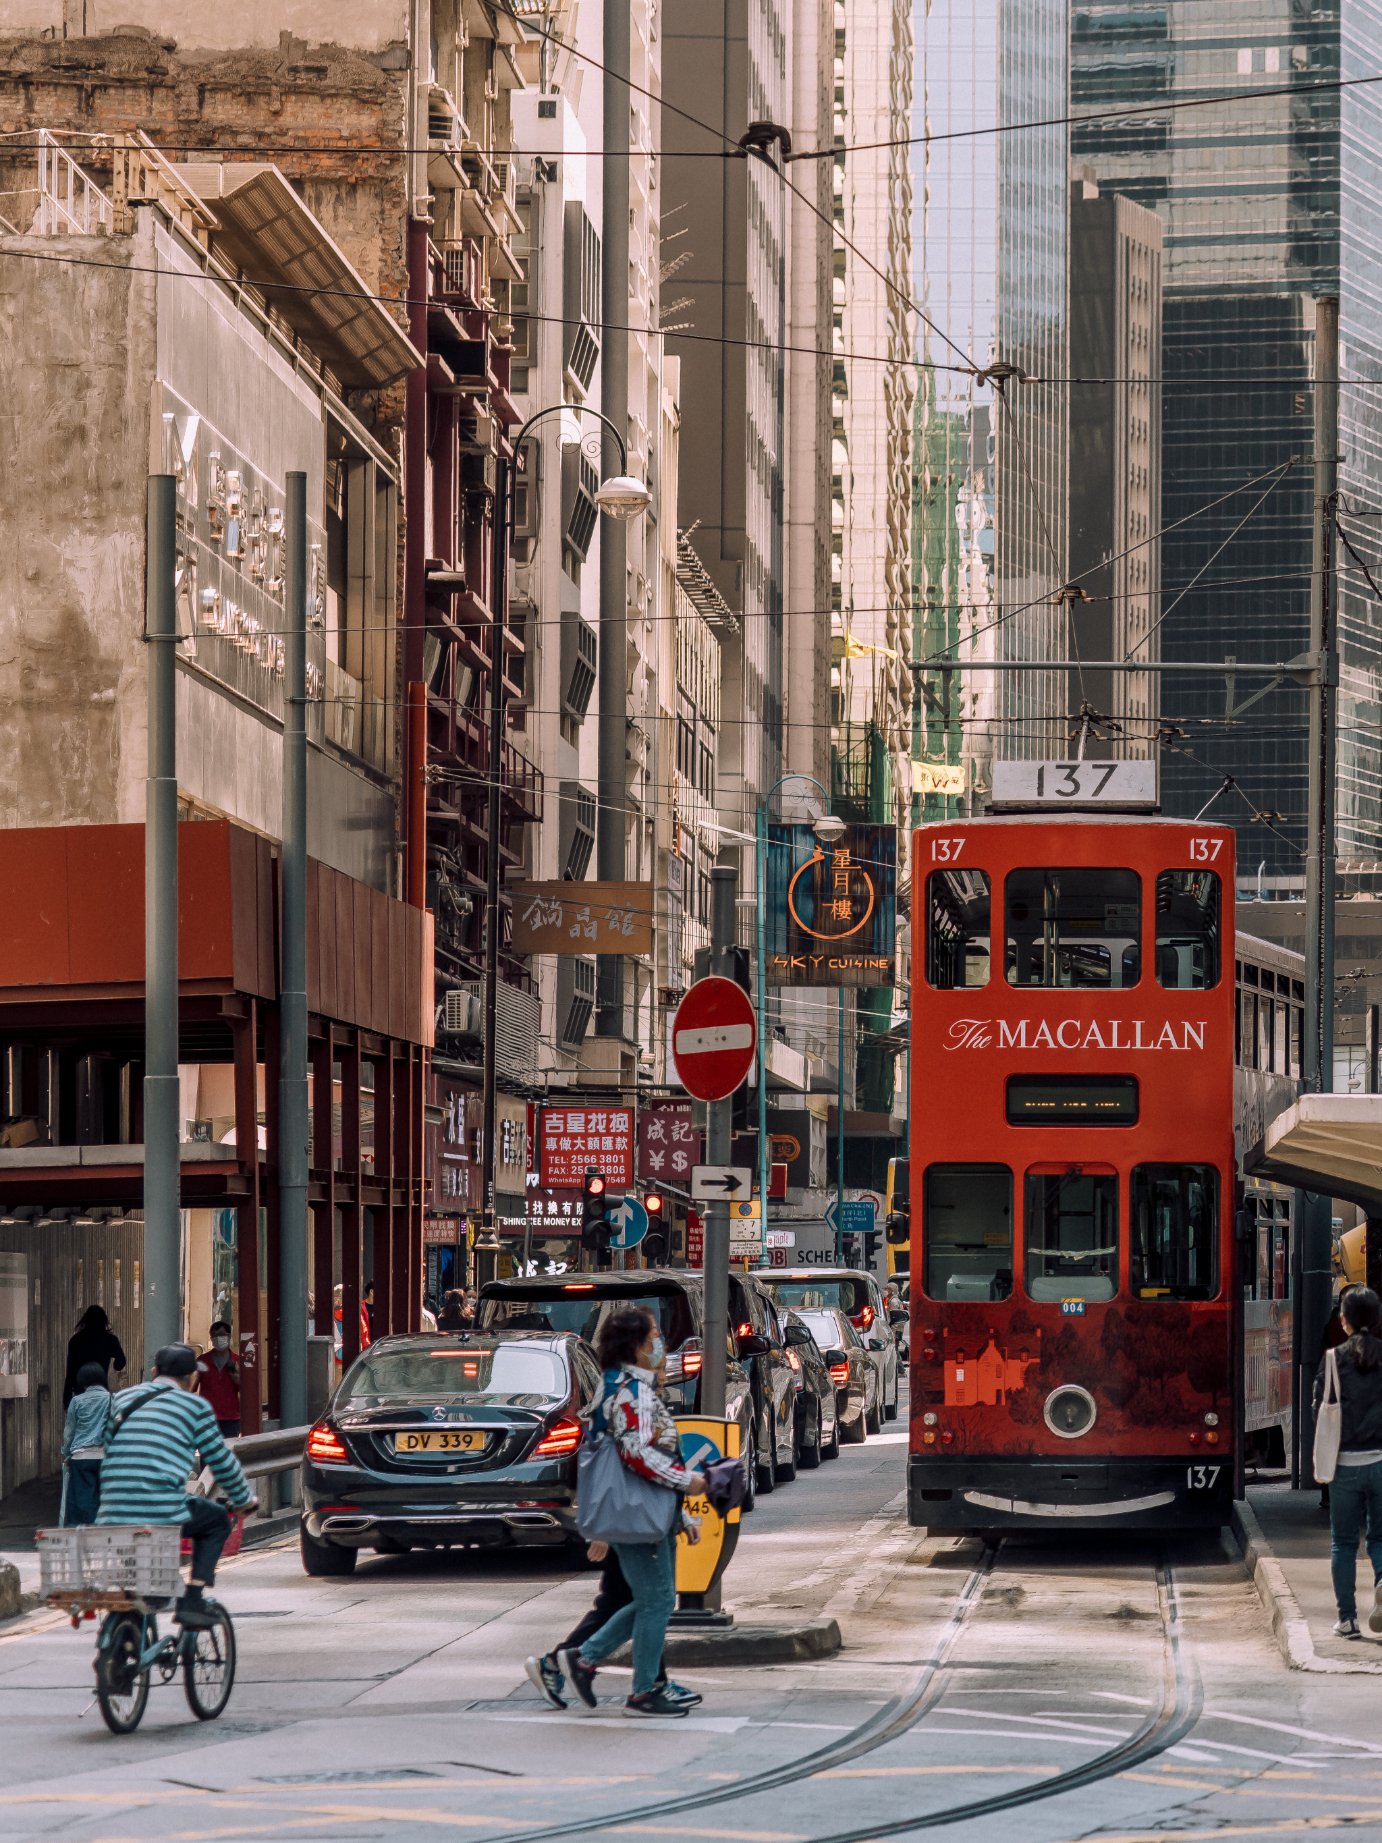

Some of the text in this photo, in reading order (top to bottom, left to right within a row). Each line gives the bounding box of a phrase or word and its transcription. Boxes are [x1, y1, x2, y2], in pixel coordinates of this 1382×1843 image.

[1037, 764, 1118, 797] 137
[931, 838, 966, 861] 137
[1189, 838, 1224, 861] 137
[822, 849, 862, 921] 星月樓
[774, 955, 889, 969] SKY CUISINE
[942, 1019, 1207, 1050] The MACALLAN
[545, 1113, 629, 1133] 吉星找換
[647, 1117, 694, 1145] 成記
[545, 1136, 628, 1151] 專做大額匯款
[549, 1154, 625, 1164] TEL: 2566 3801
[571, 1166, 589, 1174] 256
[599, 1165, 626, 1174] 3806
[548, 1177, 581, 1185] WhatsApp
[503, 1217, 526, 1226] SHING
[530, 1218, 542, 1226] EE
[543, 1218, 571, 1226] MONEY
[775, 1232, 790, 1246] aple
[1062, 1302, 1083, 1313] 004
[407, 1434, 473, 1449] DV 339
[1187, 1466, 1221, 1489] 137
